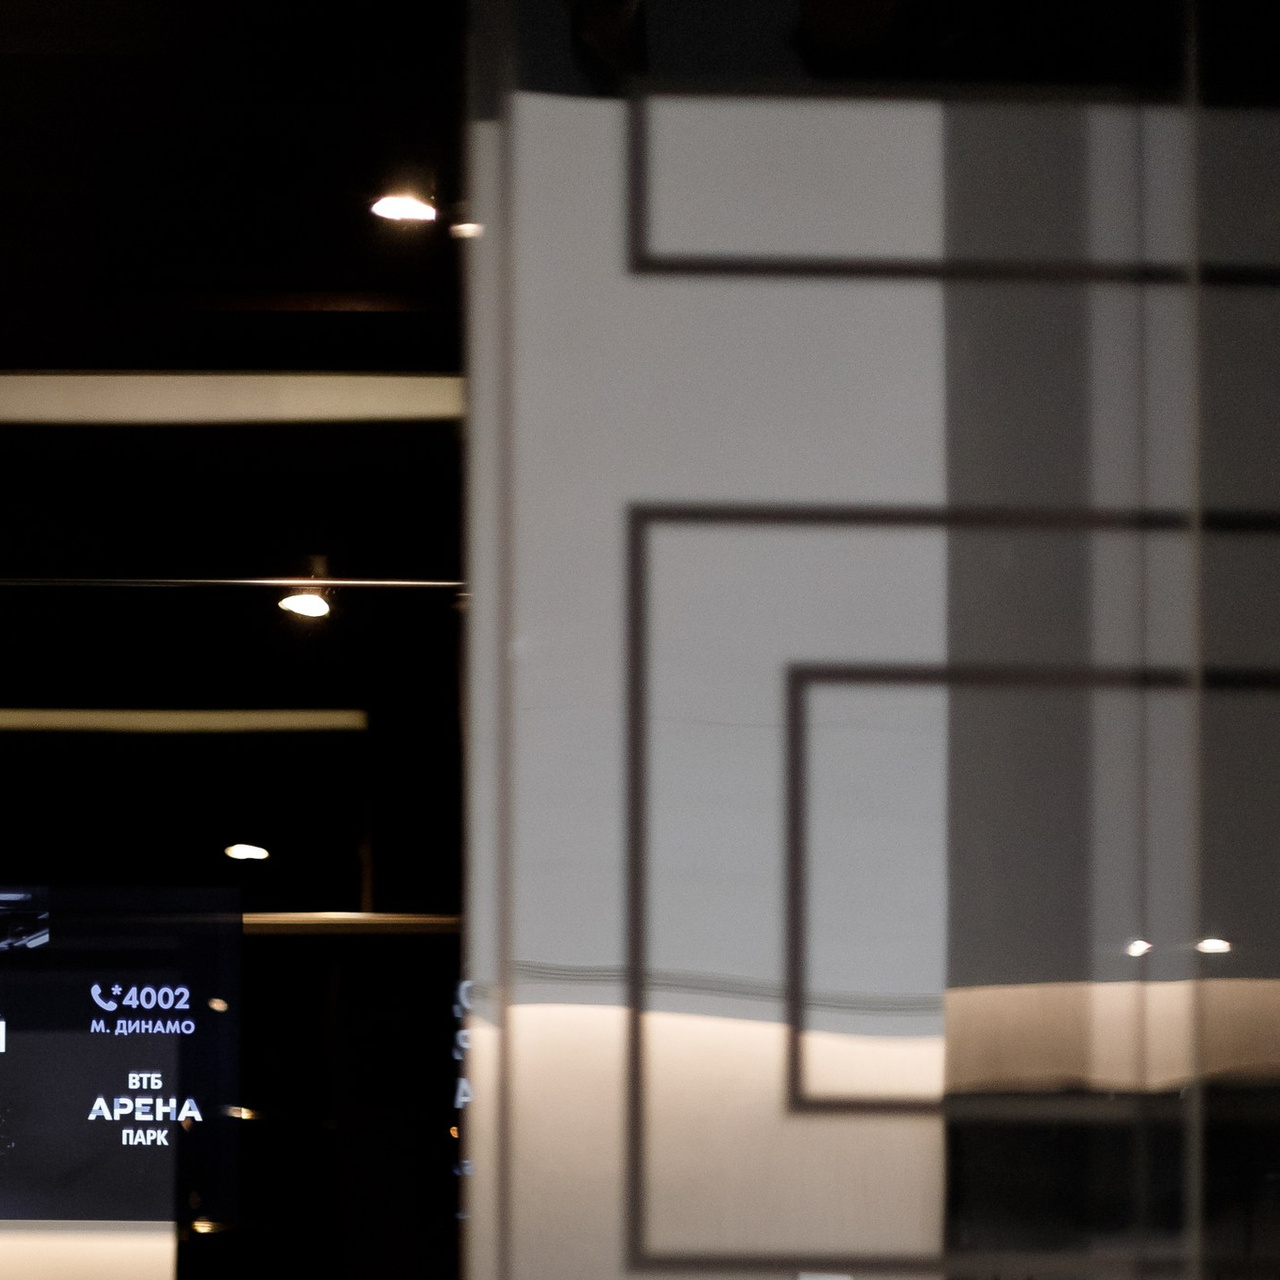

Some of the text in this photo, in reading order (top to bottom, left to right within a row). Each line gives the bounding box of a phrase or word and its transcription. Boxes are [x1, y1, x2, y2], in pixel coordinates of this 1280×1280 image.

[90, 1019, 195, 1036] М. ДИНАМО
[128, 1073, 163, 1089] ВТБ
[88, 1097, 203, 1121] АРЕНА
[122, 1129, 169, 1145] ПАРК
